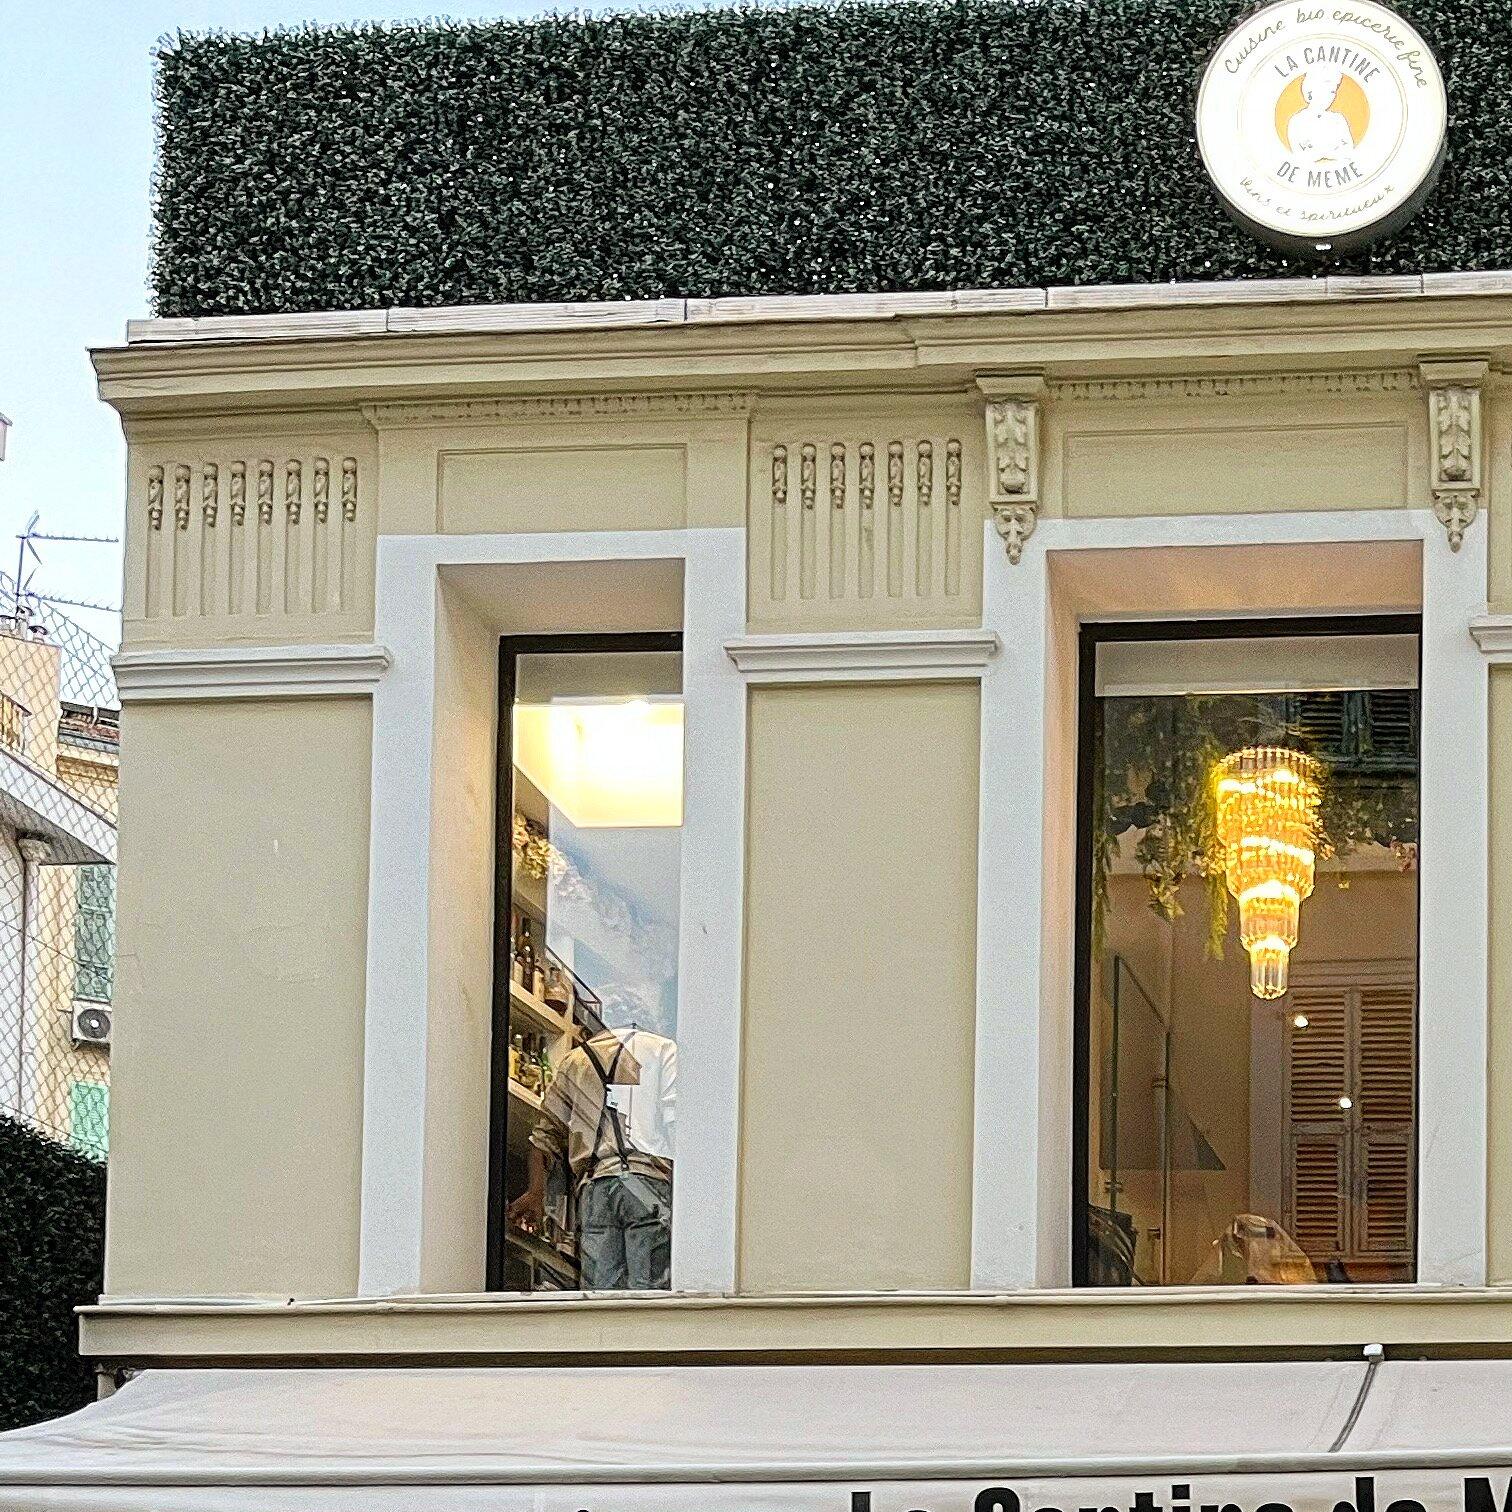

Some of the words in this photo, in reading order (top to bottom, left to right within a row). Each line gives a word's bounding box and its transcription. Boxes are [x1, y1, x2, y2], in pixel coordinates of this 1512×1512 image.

[1274, 55, 1299, 78] LA
[1304, 45, 1381, 83] CANTINE
[1297, 8, 1324, 24] bio
[1396, 50, 1428, 88] fine
[1276, 161, 1301, 183] DE
